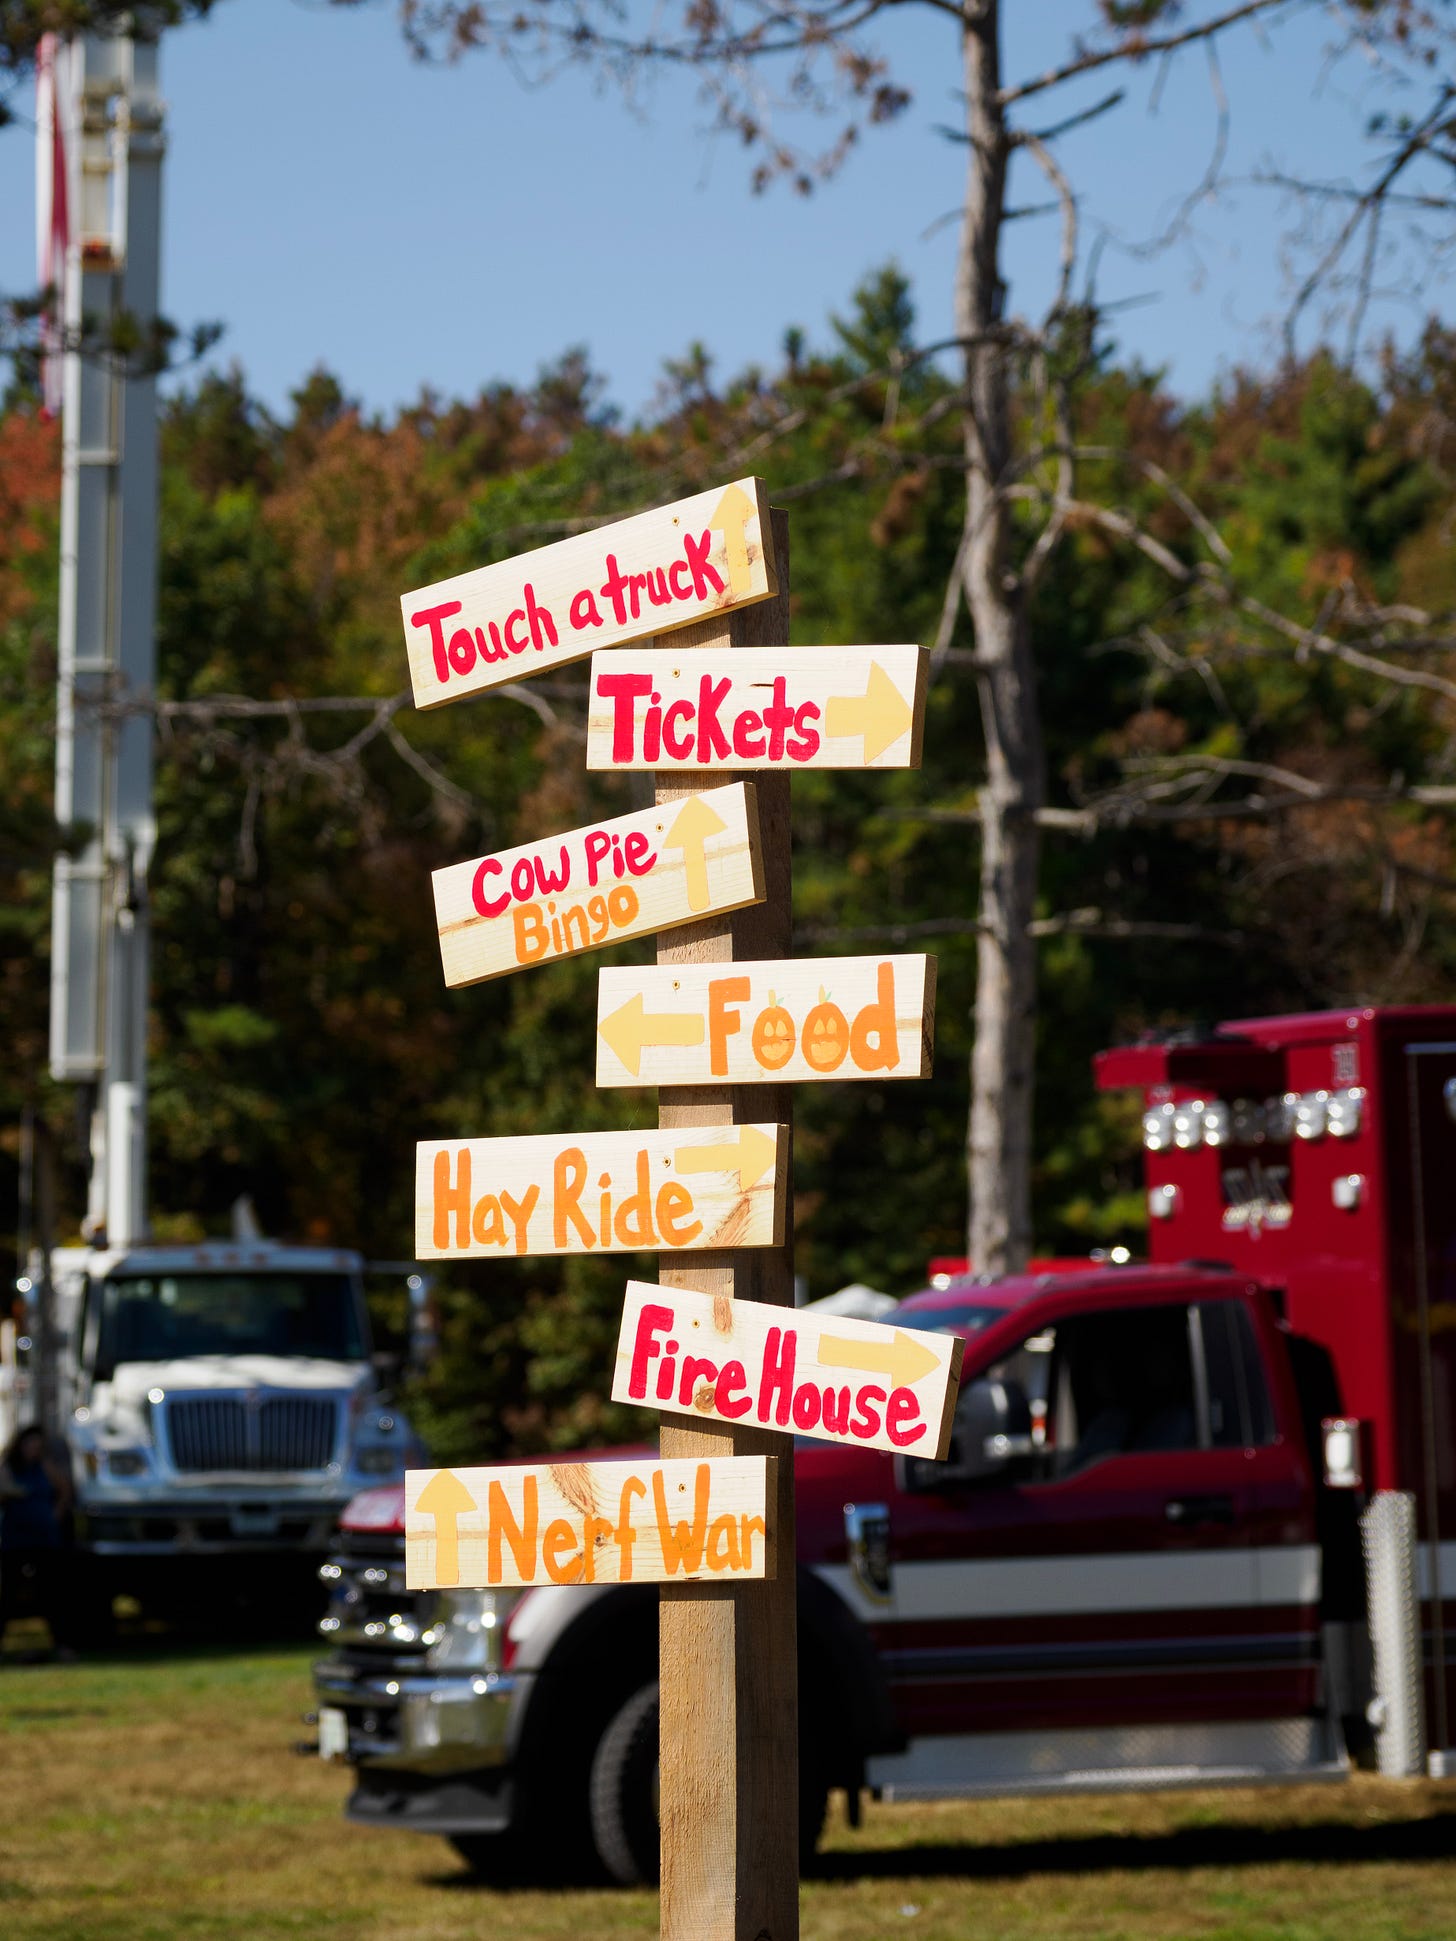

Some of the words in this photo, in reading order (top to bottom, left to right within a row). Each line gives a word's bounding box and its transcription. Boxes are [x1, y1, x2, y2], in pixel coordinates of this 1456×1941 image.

[411, 583, 559, 682] Touch
[569, 589, 604, 630] a
[472, 845, 571, 919] Cow
[584, 830, 658, 887] Pie
[512, 884, 640, 965] Bingo
[708, 961, 900, 1075] Food
[433, 1148, 540, 1254] Hay
[553, 1147, 703, 1249] Ride
[628, 1304, 753, 1419] Fire
[757, 1326, 928, 1447] House
[487, 1475, 647, 1585] Nerf
[652, 1463, 766, 1575] War
